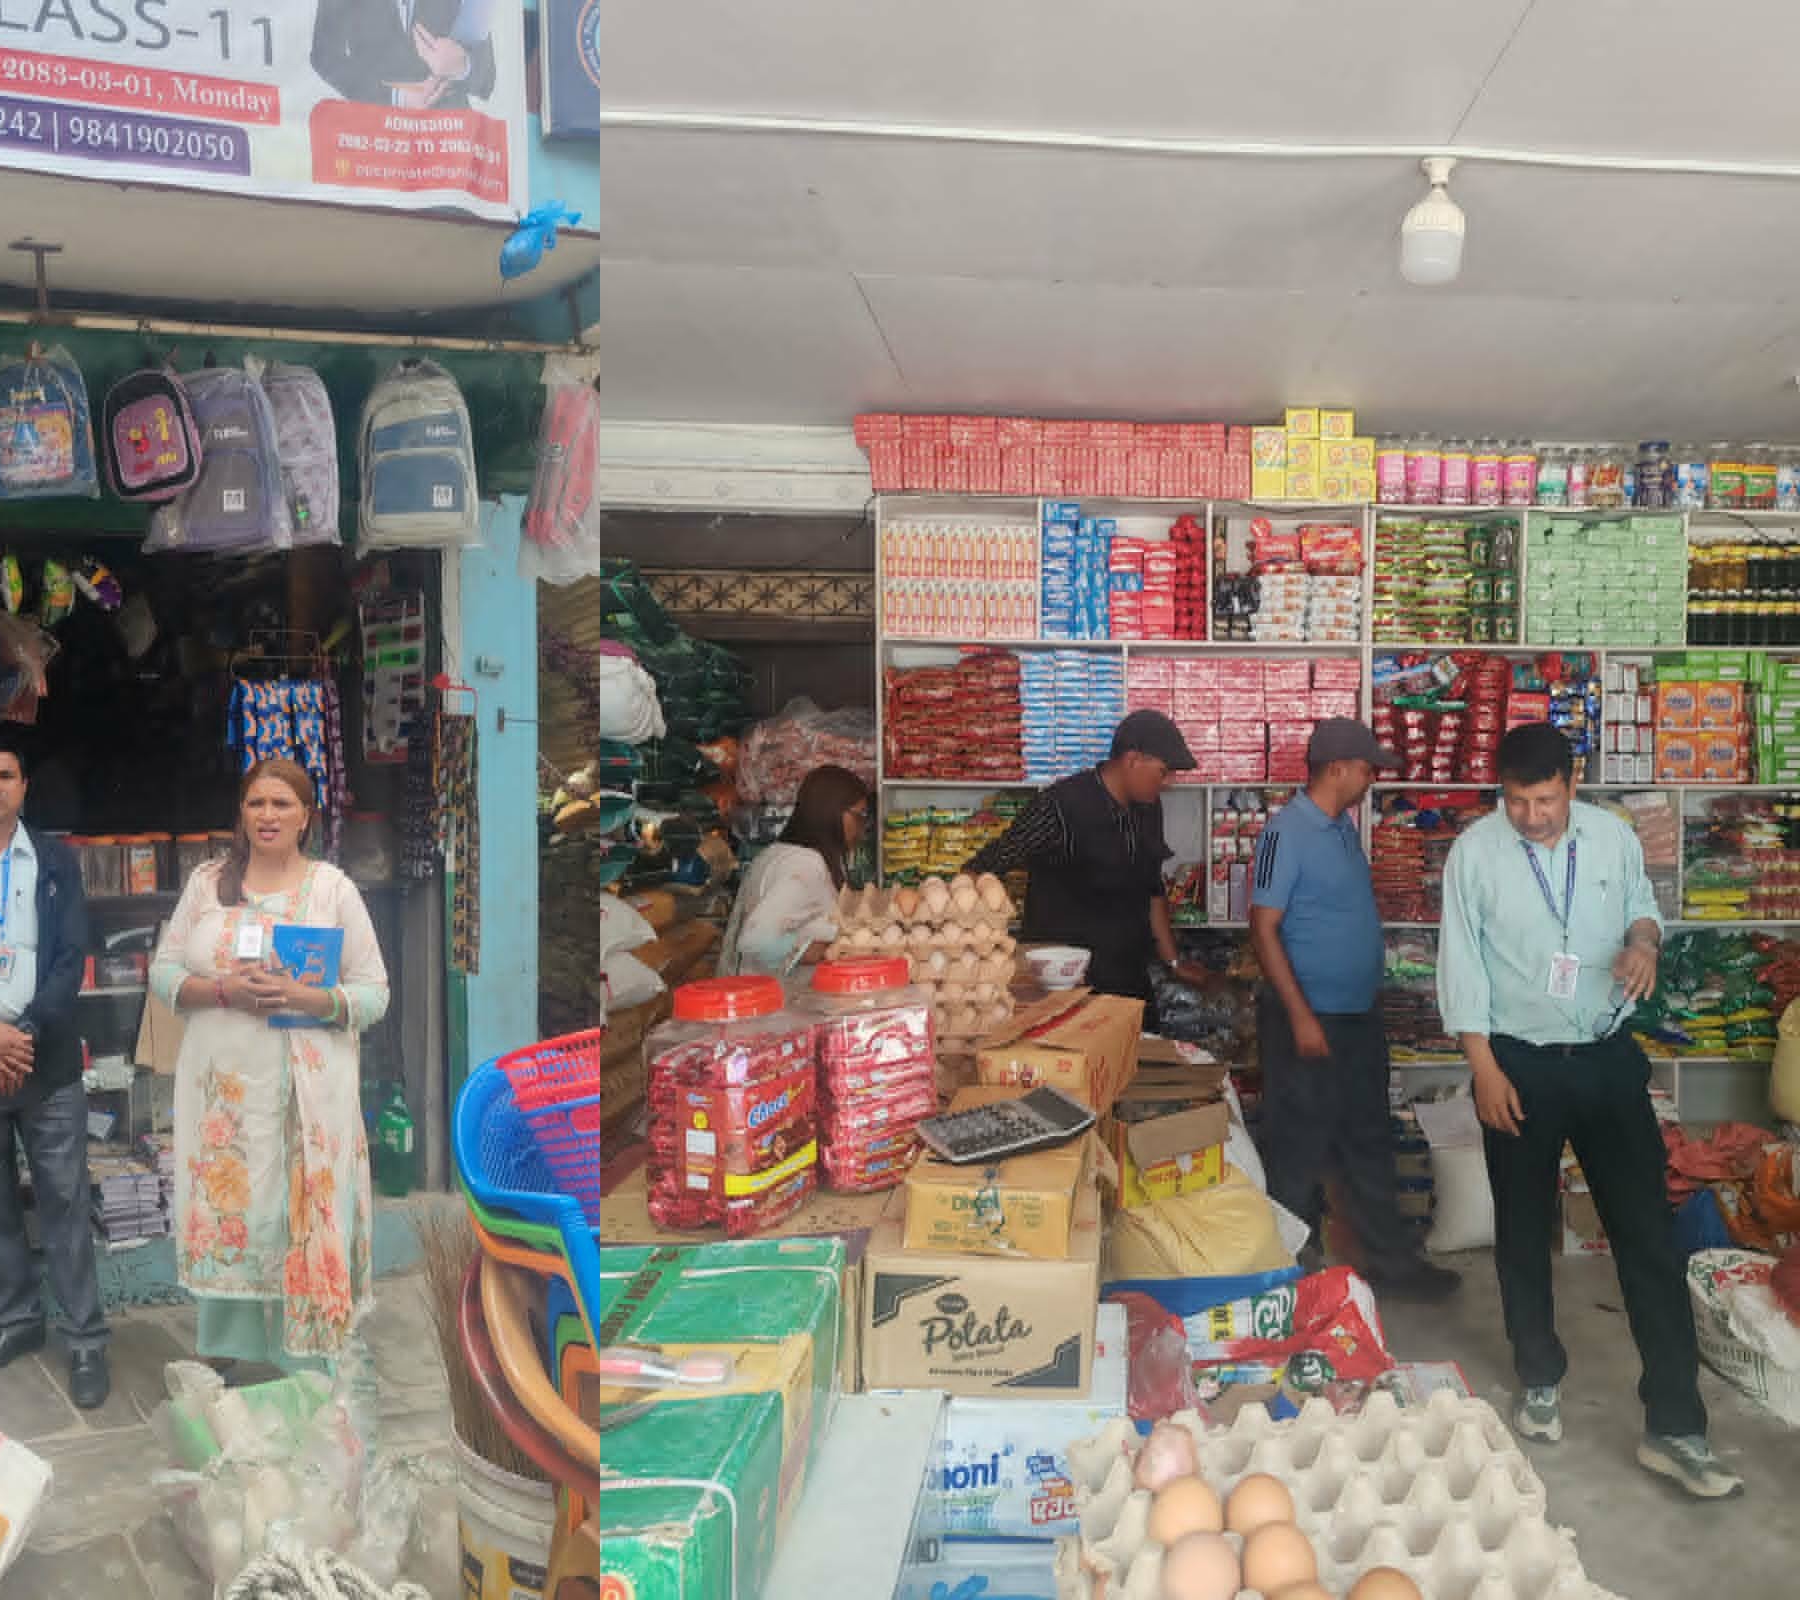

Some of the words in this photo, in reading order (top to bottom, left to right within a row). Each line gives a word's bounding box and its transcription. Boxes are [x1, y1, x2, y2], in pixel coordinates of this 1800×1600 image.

[171, 77, 273, 121] Monday
[69, 118, 234, 161] 9841902050
[384, 115, 464, 132] ADMISSION
[415, 138, 436, 154] TO
[919, 1303, 1033, 1356] Potata
